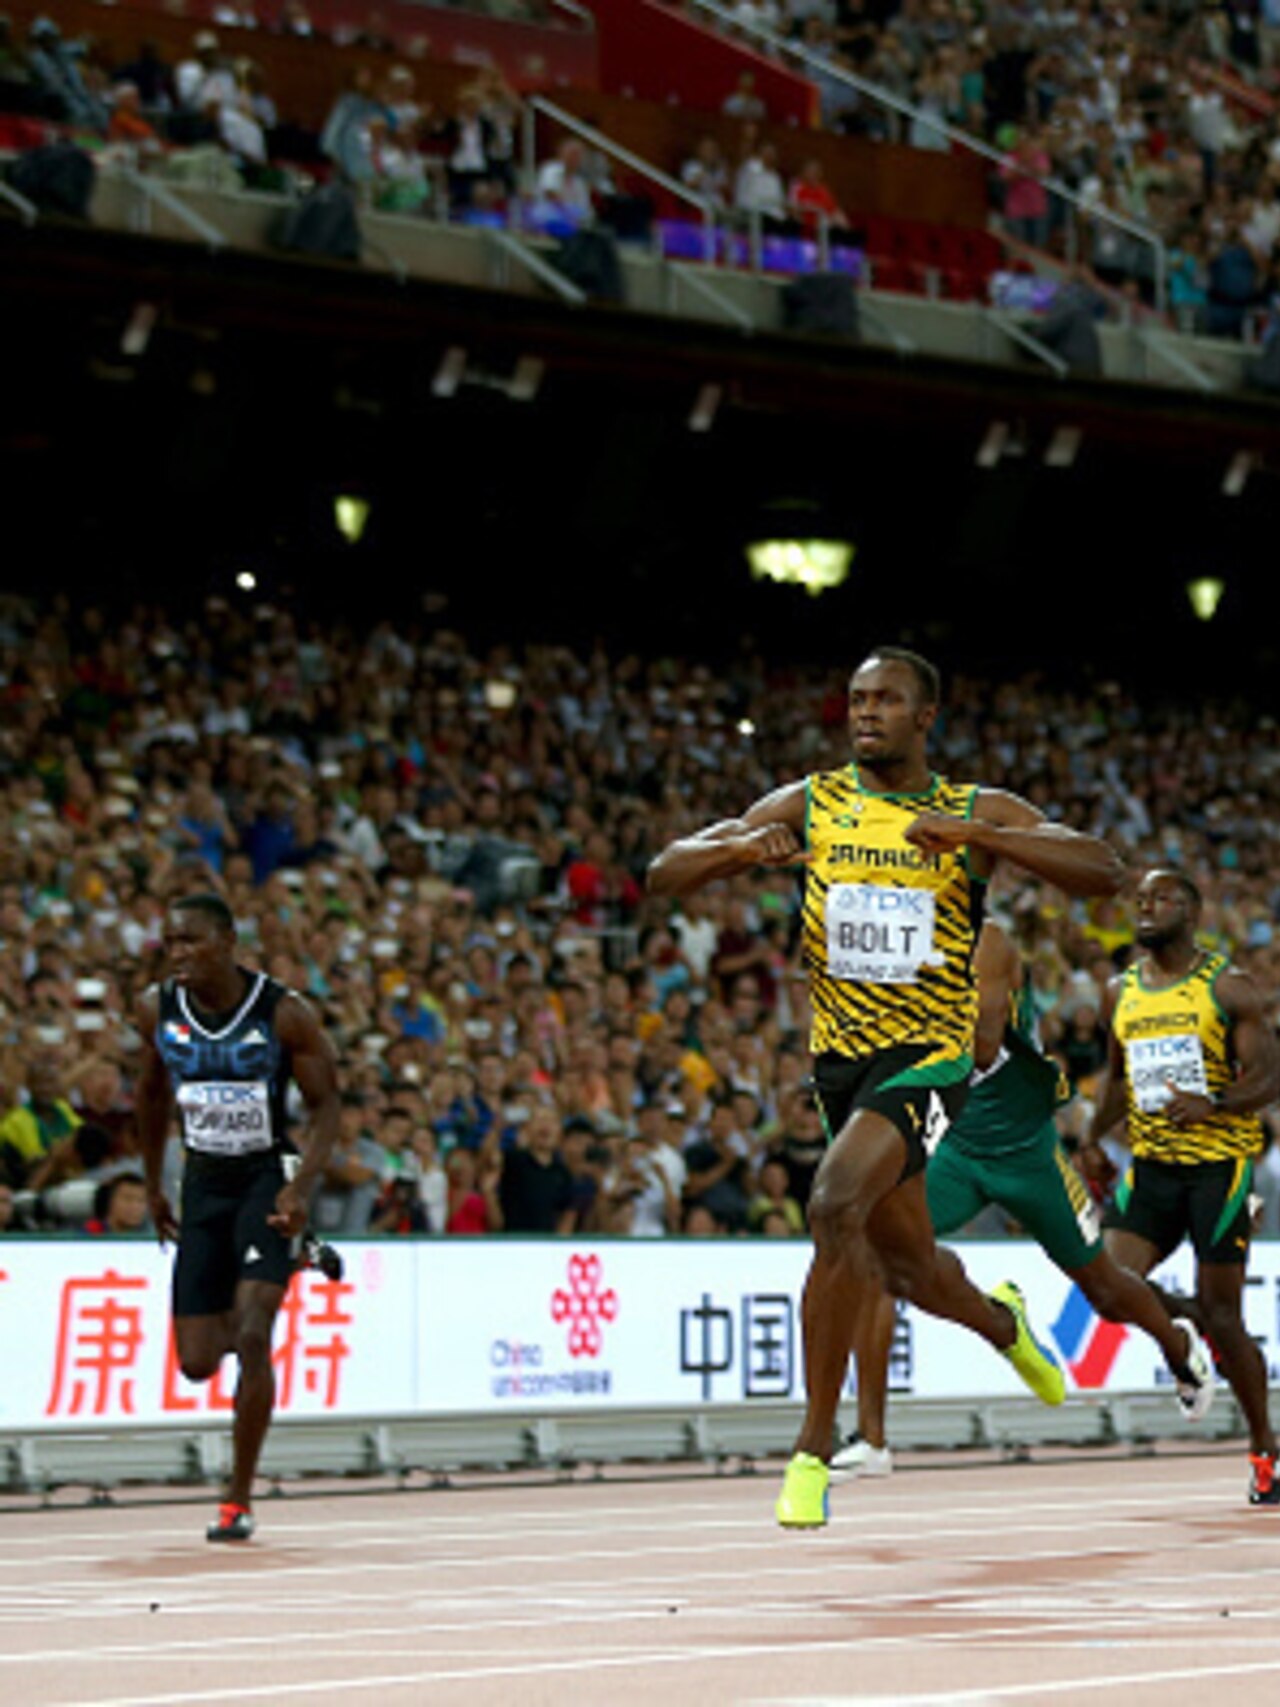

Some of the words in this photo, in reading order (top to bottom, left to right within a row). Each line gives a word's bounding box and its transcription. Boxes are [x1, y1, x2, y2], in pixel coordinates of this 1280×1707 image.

[860, 889, 924, 914] TDK
[838, 921, 918, 955] BOLT
[1147, 1037, 1192, 1057] TDK
[205, 1086, 258, 1104] TDK
